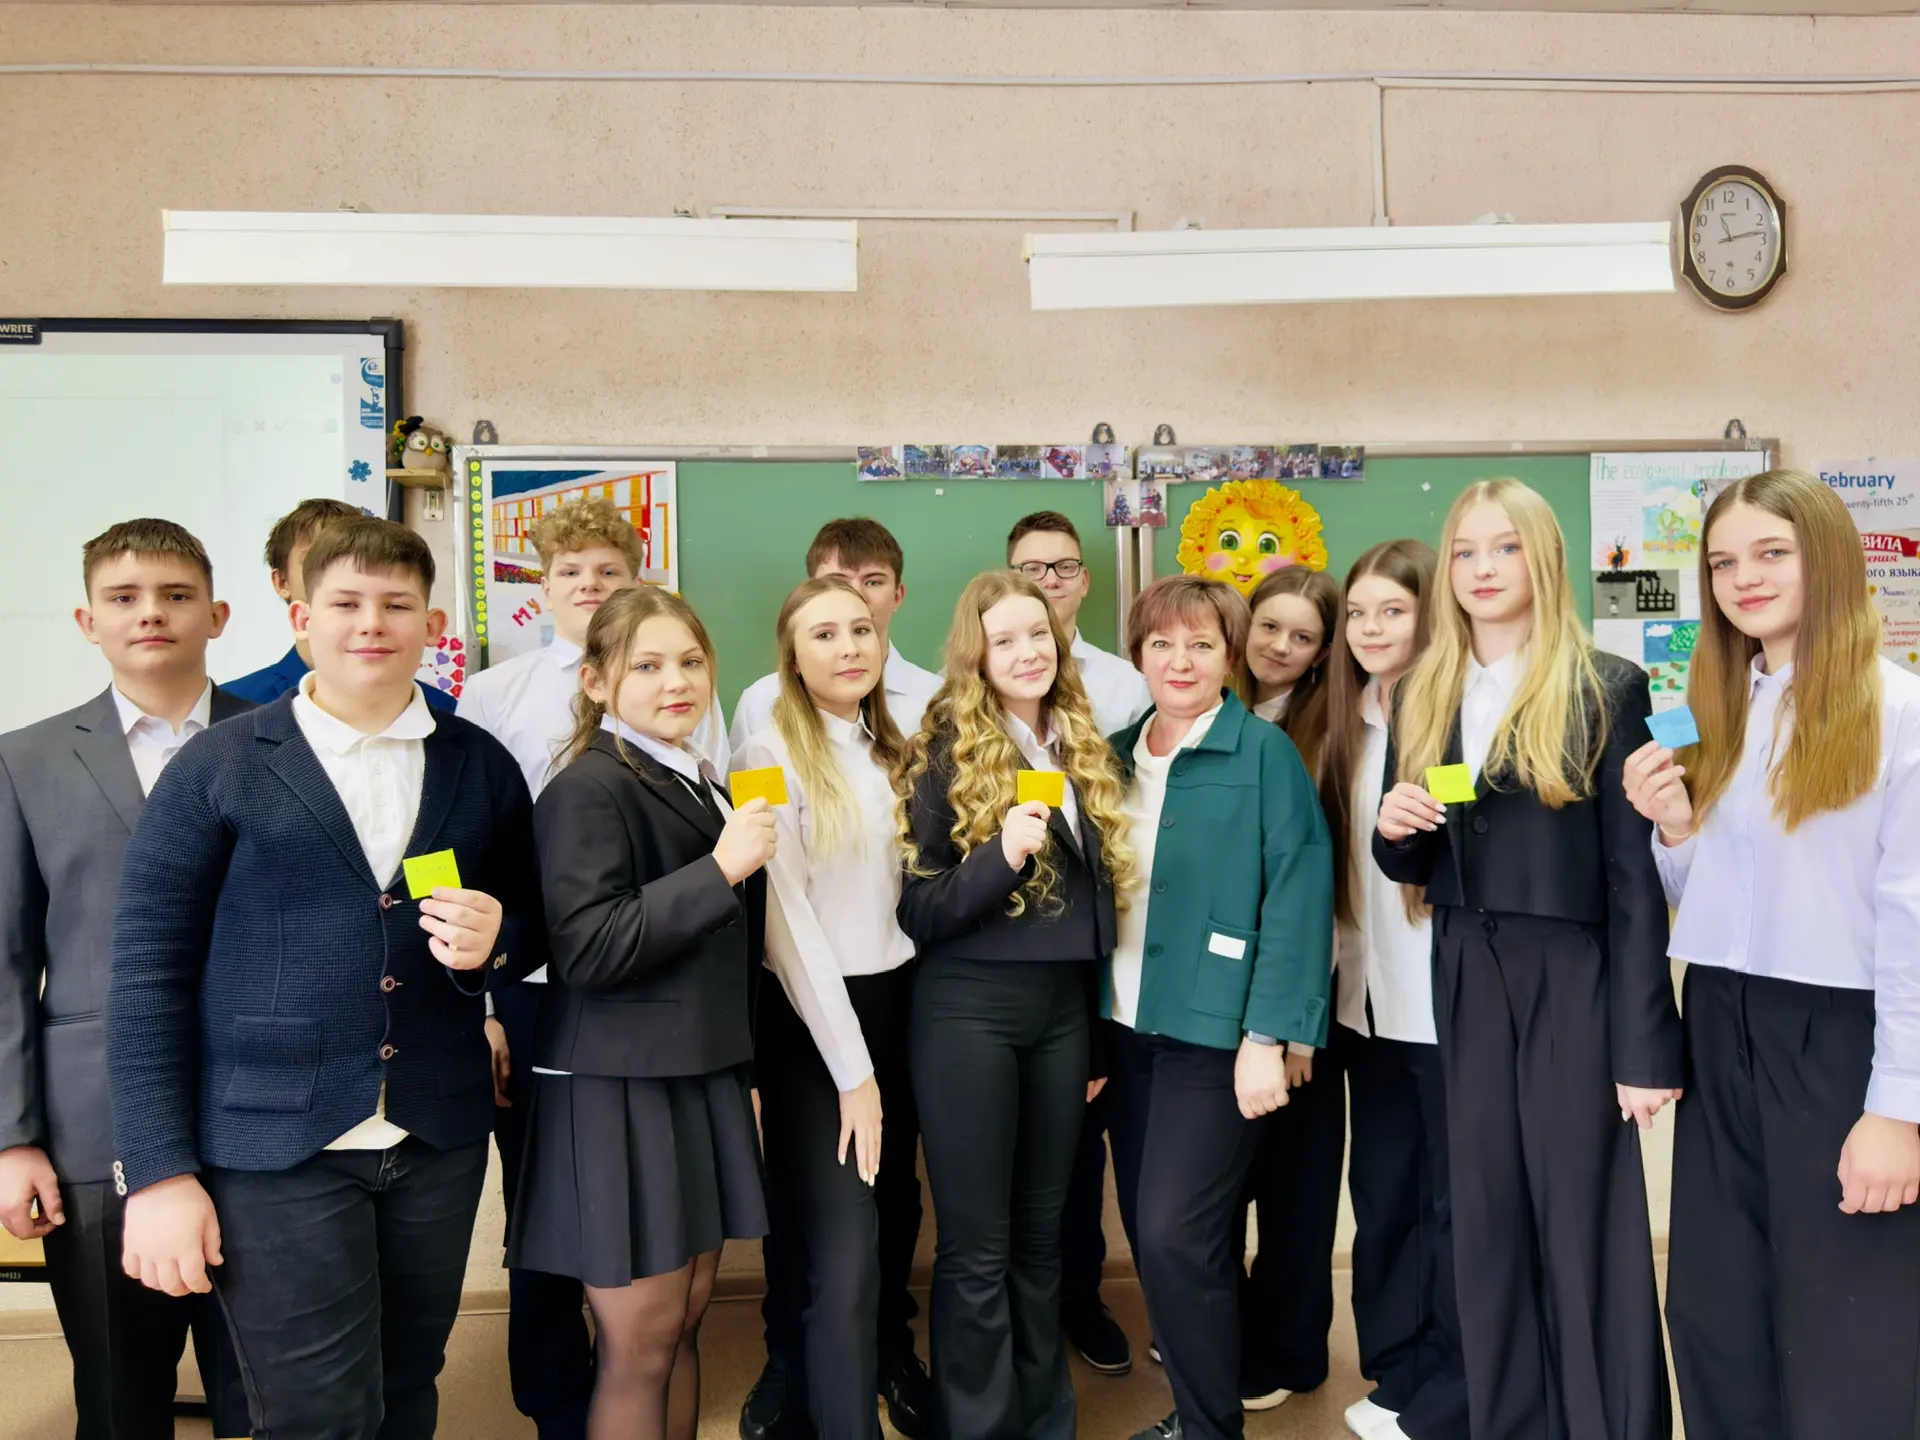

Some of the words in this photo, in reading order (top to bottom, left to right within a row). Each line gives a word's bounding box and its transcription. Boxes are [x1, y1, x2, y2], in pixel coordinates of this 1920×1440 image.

[1723, 190, 1735, 204] 12
[1705, 198, 1715, 211] 11
[1745, 198, 1750, 211] 1
[1696, 214, 1708, 228] 10
[1756, 213, 1764, 226] 2
[1693, 232, 1701, 246] 9
[1760, 232, 1767, 246] 3
[1698, 250, 1707, 264] 8
[1754, 250, 1762, 263] 4
[1708, 269, 1716, 282] 7
[1746, 268, 1755, 281] 5
[1726, 276, 1735, 289] 6
[1594, 456, 1618, 480] The
[1820, 471, 1896, 490] February
